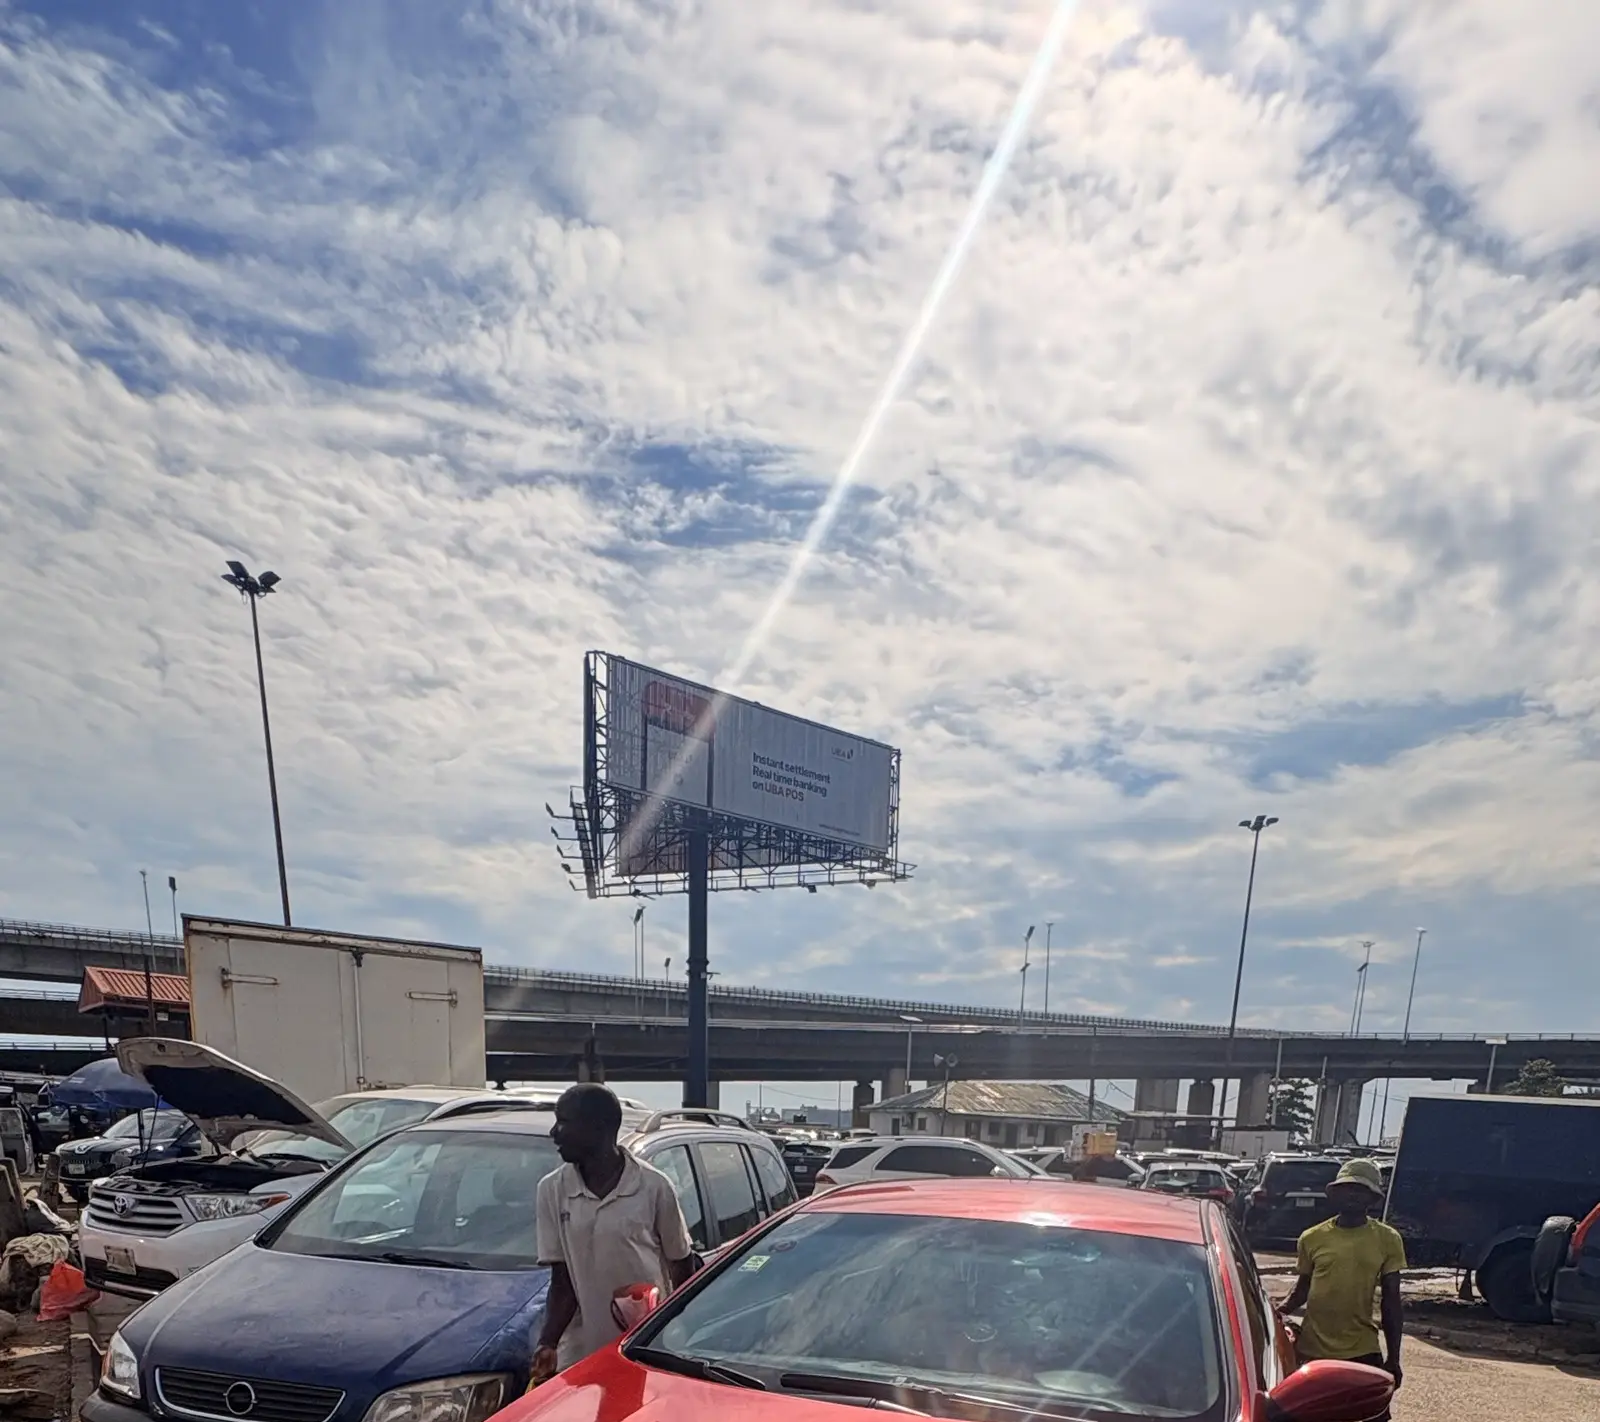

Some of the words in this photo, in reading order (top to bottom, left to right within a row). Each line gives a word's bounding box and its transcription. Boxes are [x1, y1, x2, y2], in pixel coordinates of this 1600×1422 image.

[753, 752, 784, 770] Instant
[785, 763, 830, 784] settlement
[753, 765, 773, 779] Real
[773, 769, 792, 786] time
[793, 776, 827, 798] banking
[752, 781, 764, 792] on
[765, 781, 784, 797] UBA
[785, 787, 805, 802] POS
